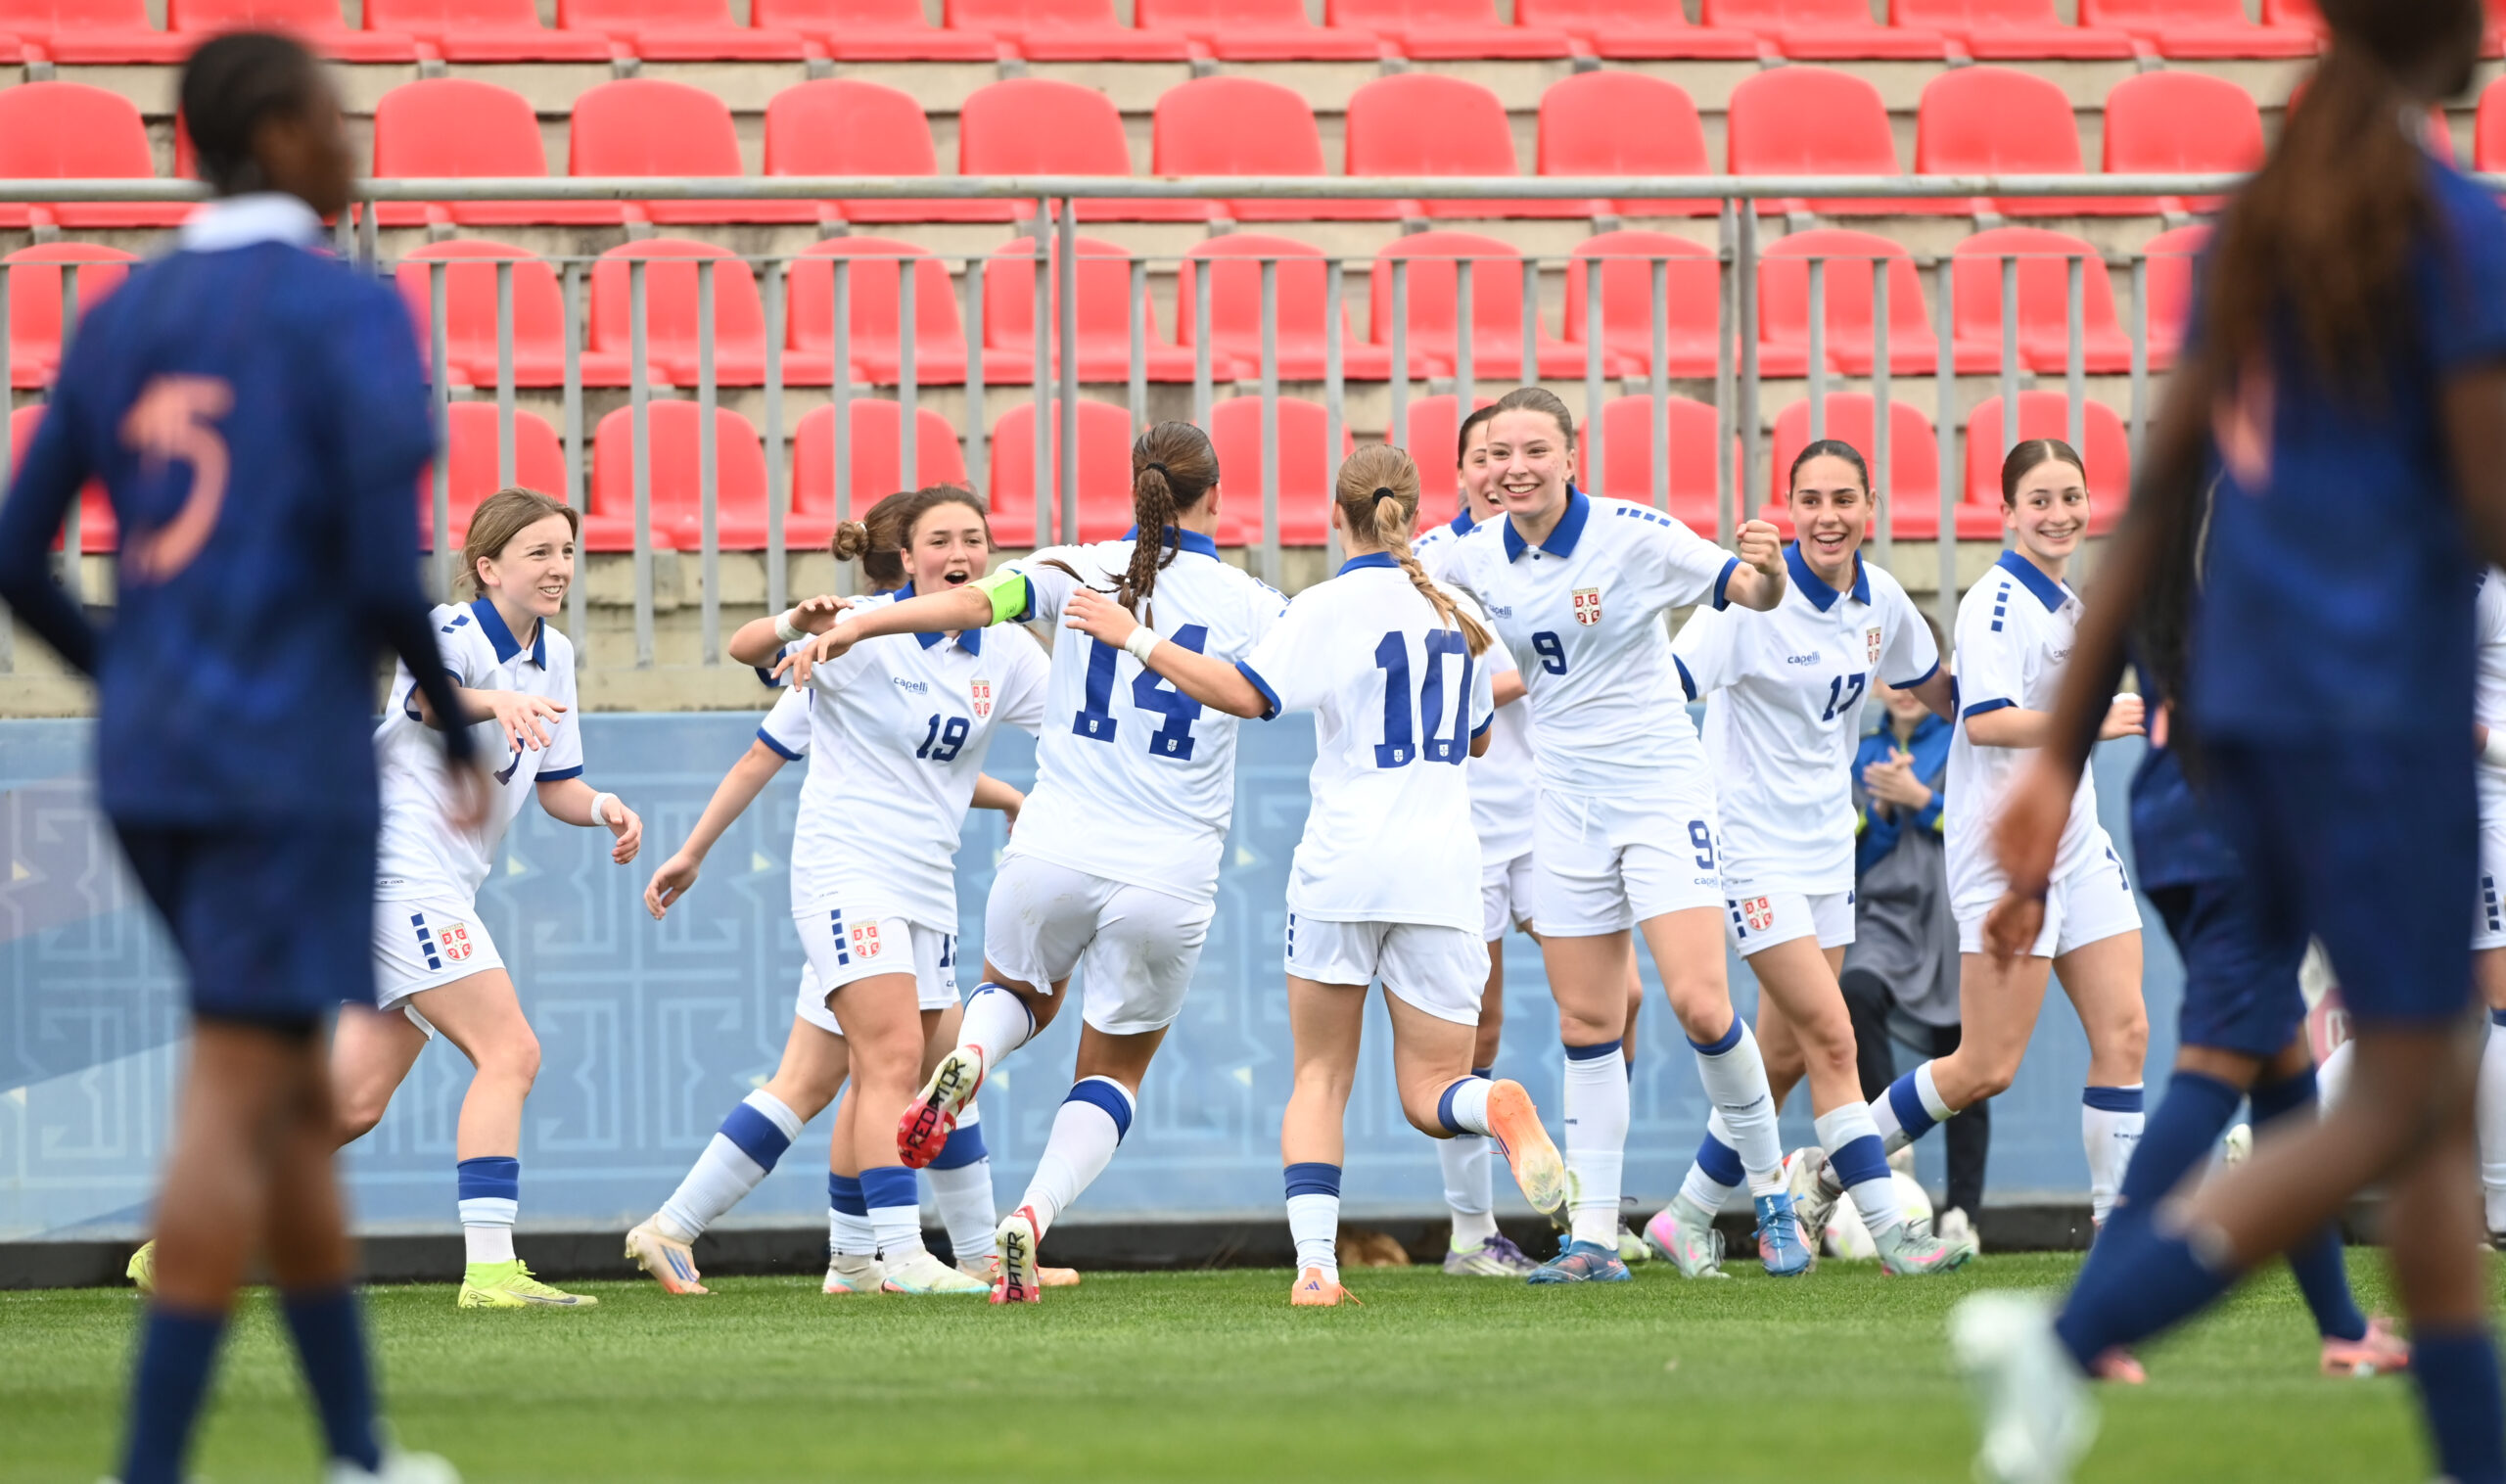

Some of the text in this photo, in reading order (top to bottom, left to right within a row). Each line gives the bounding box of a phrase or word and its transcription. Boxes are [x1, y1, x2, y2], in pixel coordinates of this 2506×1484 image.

[121, 373, 234, 584] 5
[1531, 631, 1567, 676] 9
[893, 676, 929, 694] capelli
[1072, 624, 1208, 762] 14
[1374, 627, 1474, 768] 10
[1822, 672, 1866, 722] 17
[492, 736, 525, 787] 7
[916, 713, 971, 762] 19
[1688, 819, 1715, 870] 9
